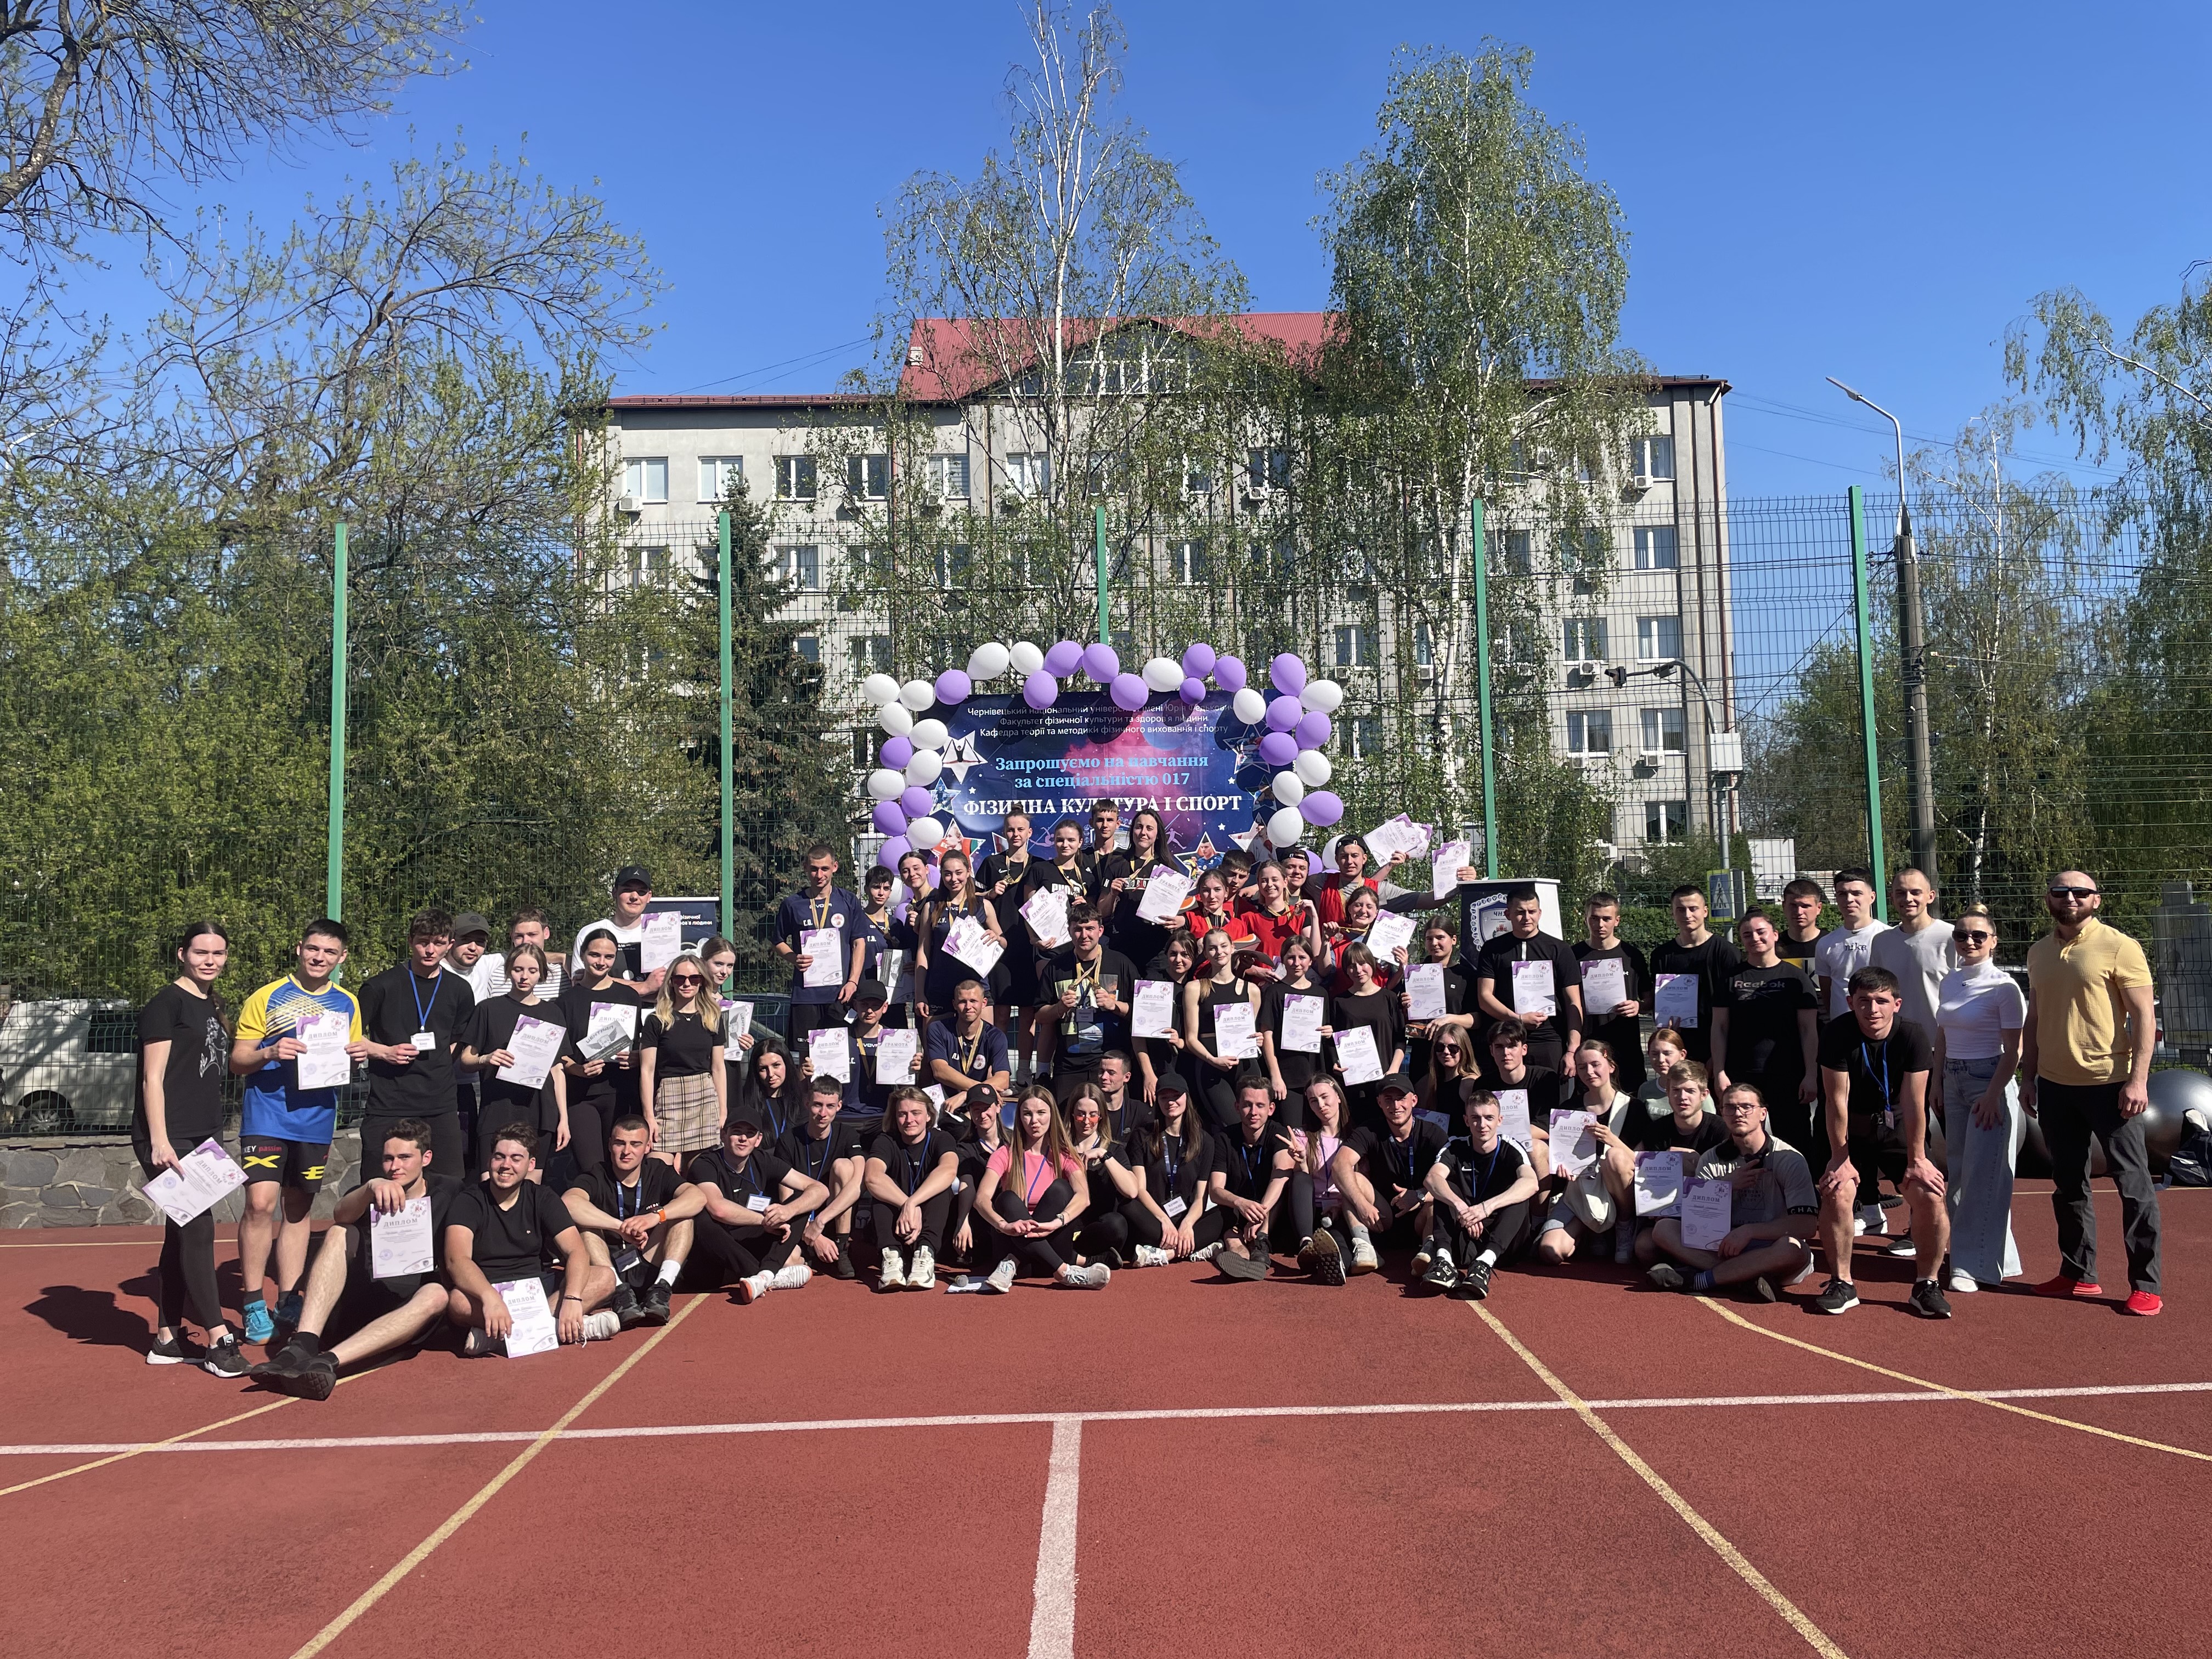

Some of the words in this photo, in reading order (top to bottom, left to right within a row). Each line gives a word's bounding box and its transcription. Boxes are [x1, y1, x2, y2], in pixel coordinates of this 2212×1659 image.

[968, 707, 1026, 718] Чернівецький
[1000, 718, 1042, 726] Факультет
[1045, 716, 1083, 726] фізичної
[1085, 716, 1123, 725] культури
[980, 728, 1019, 738] Кафедра
[1022, 727, 1045, 737] теорії
[1057, 726, 1099, 736] методики
[1101, 725, 1146, 735] фізичного
[1199, 725, 1228, 733] спорту
[996, 758, 1101, 774] Запрошуємо
[1104, 757, 1124, 768] на
[1128, 757, 1209, 767] навчання
[1014, 777, 1032, 788] за
[1035, 772, 1159, 789] спеціальністю
[1162, 772, 1190, 786] 017
[1060, 797, 1160, 813] КУЛТУРА
[1176, 795, 1242, 811] СПОРТ
[1844, 943, 1867, 951] nike
[1734, 980, 1786, 989] Reebok
[308, 1031, 337, 1040] ДИПЛОМ
[1344, 1040, 1365, 1048] ДИПЛОМ
[196, 1159, 223, 1184] ДИПЛОМ
[1692, 1194, 1720, 1203] ДИПЛОМ
[383, 1218, 417, 1228] ДИПЛОМ
[508, 1295, 535, 1305] ДИПЛОМ
